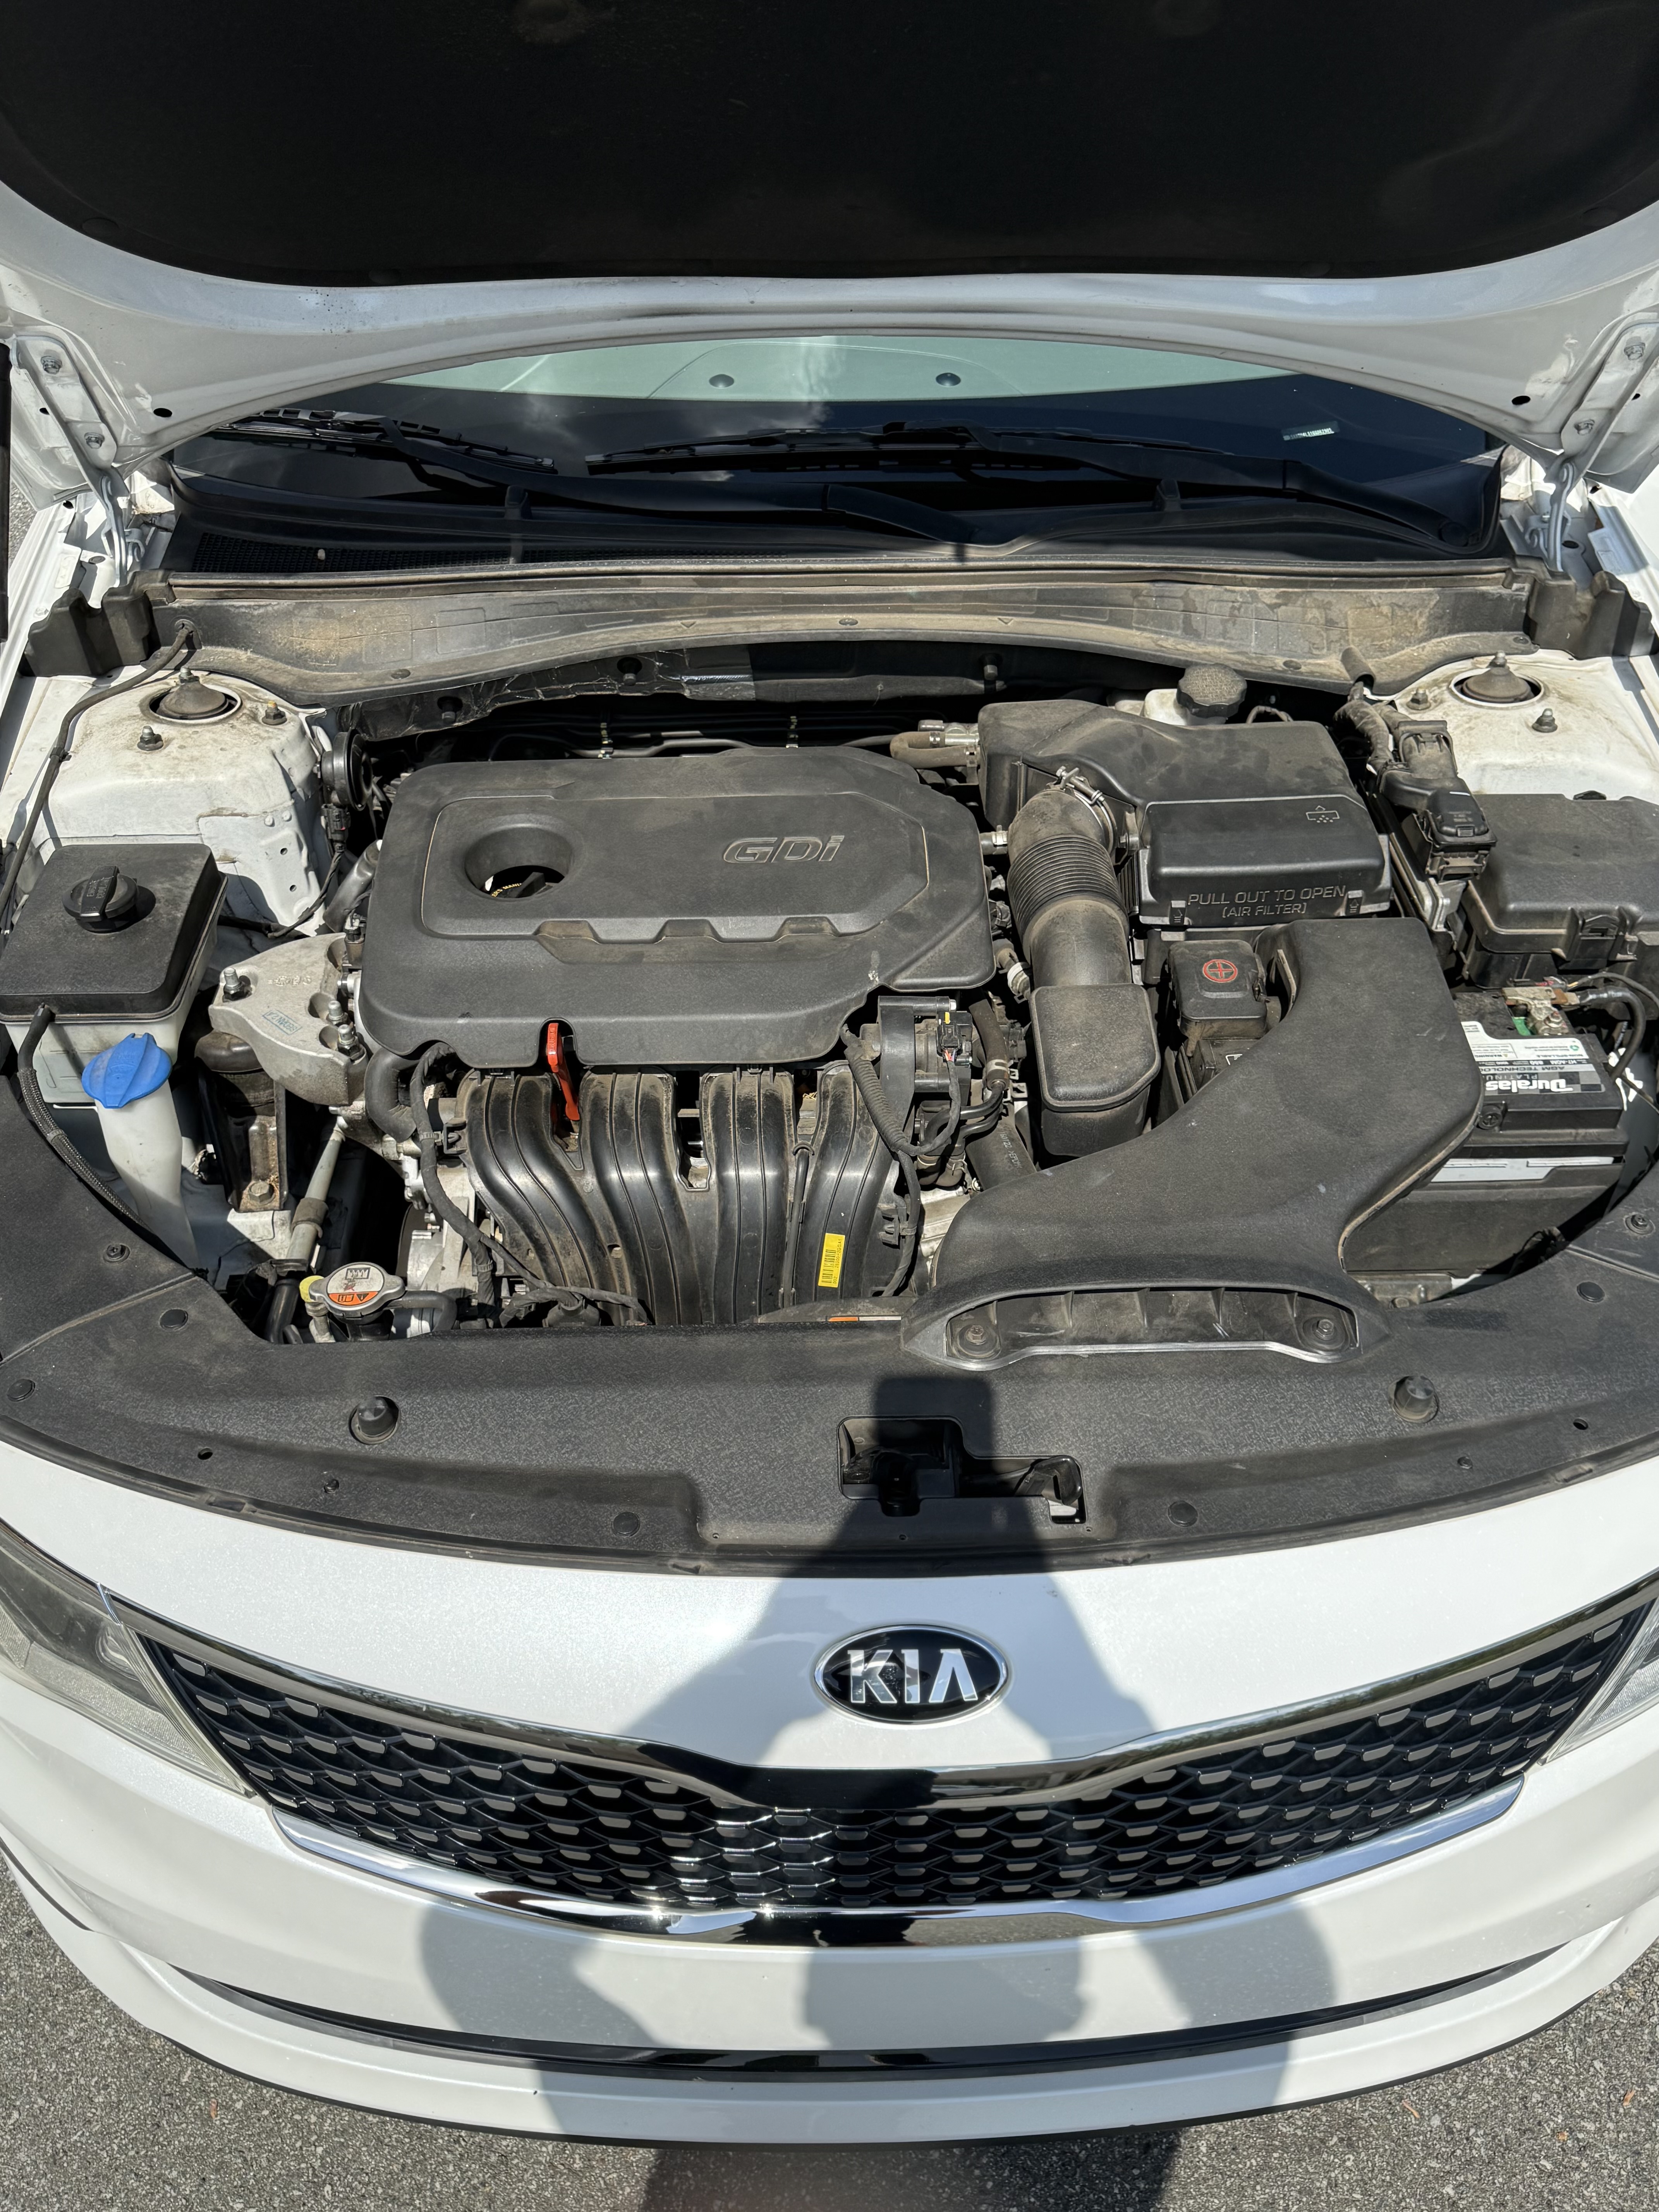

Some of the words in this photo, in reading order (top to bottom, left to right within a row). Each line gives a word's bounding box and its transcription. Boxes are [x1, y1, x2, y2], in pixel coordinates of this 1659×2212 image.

[723, 835, 845, 863] GDi
[1187, 893, 1230, 905] PULL
[1235, 891, 1270, 903] OUT
[1274, 889, 1295, 901] TO
[1300, 885, 1346, 899] OPEN
[1486, 1079, 1573, 1092] Duralas
[847, 1649, 978, 1704] KIA
